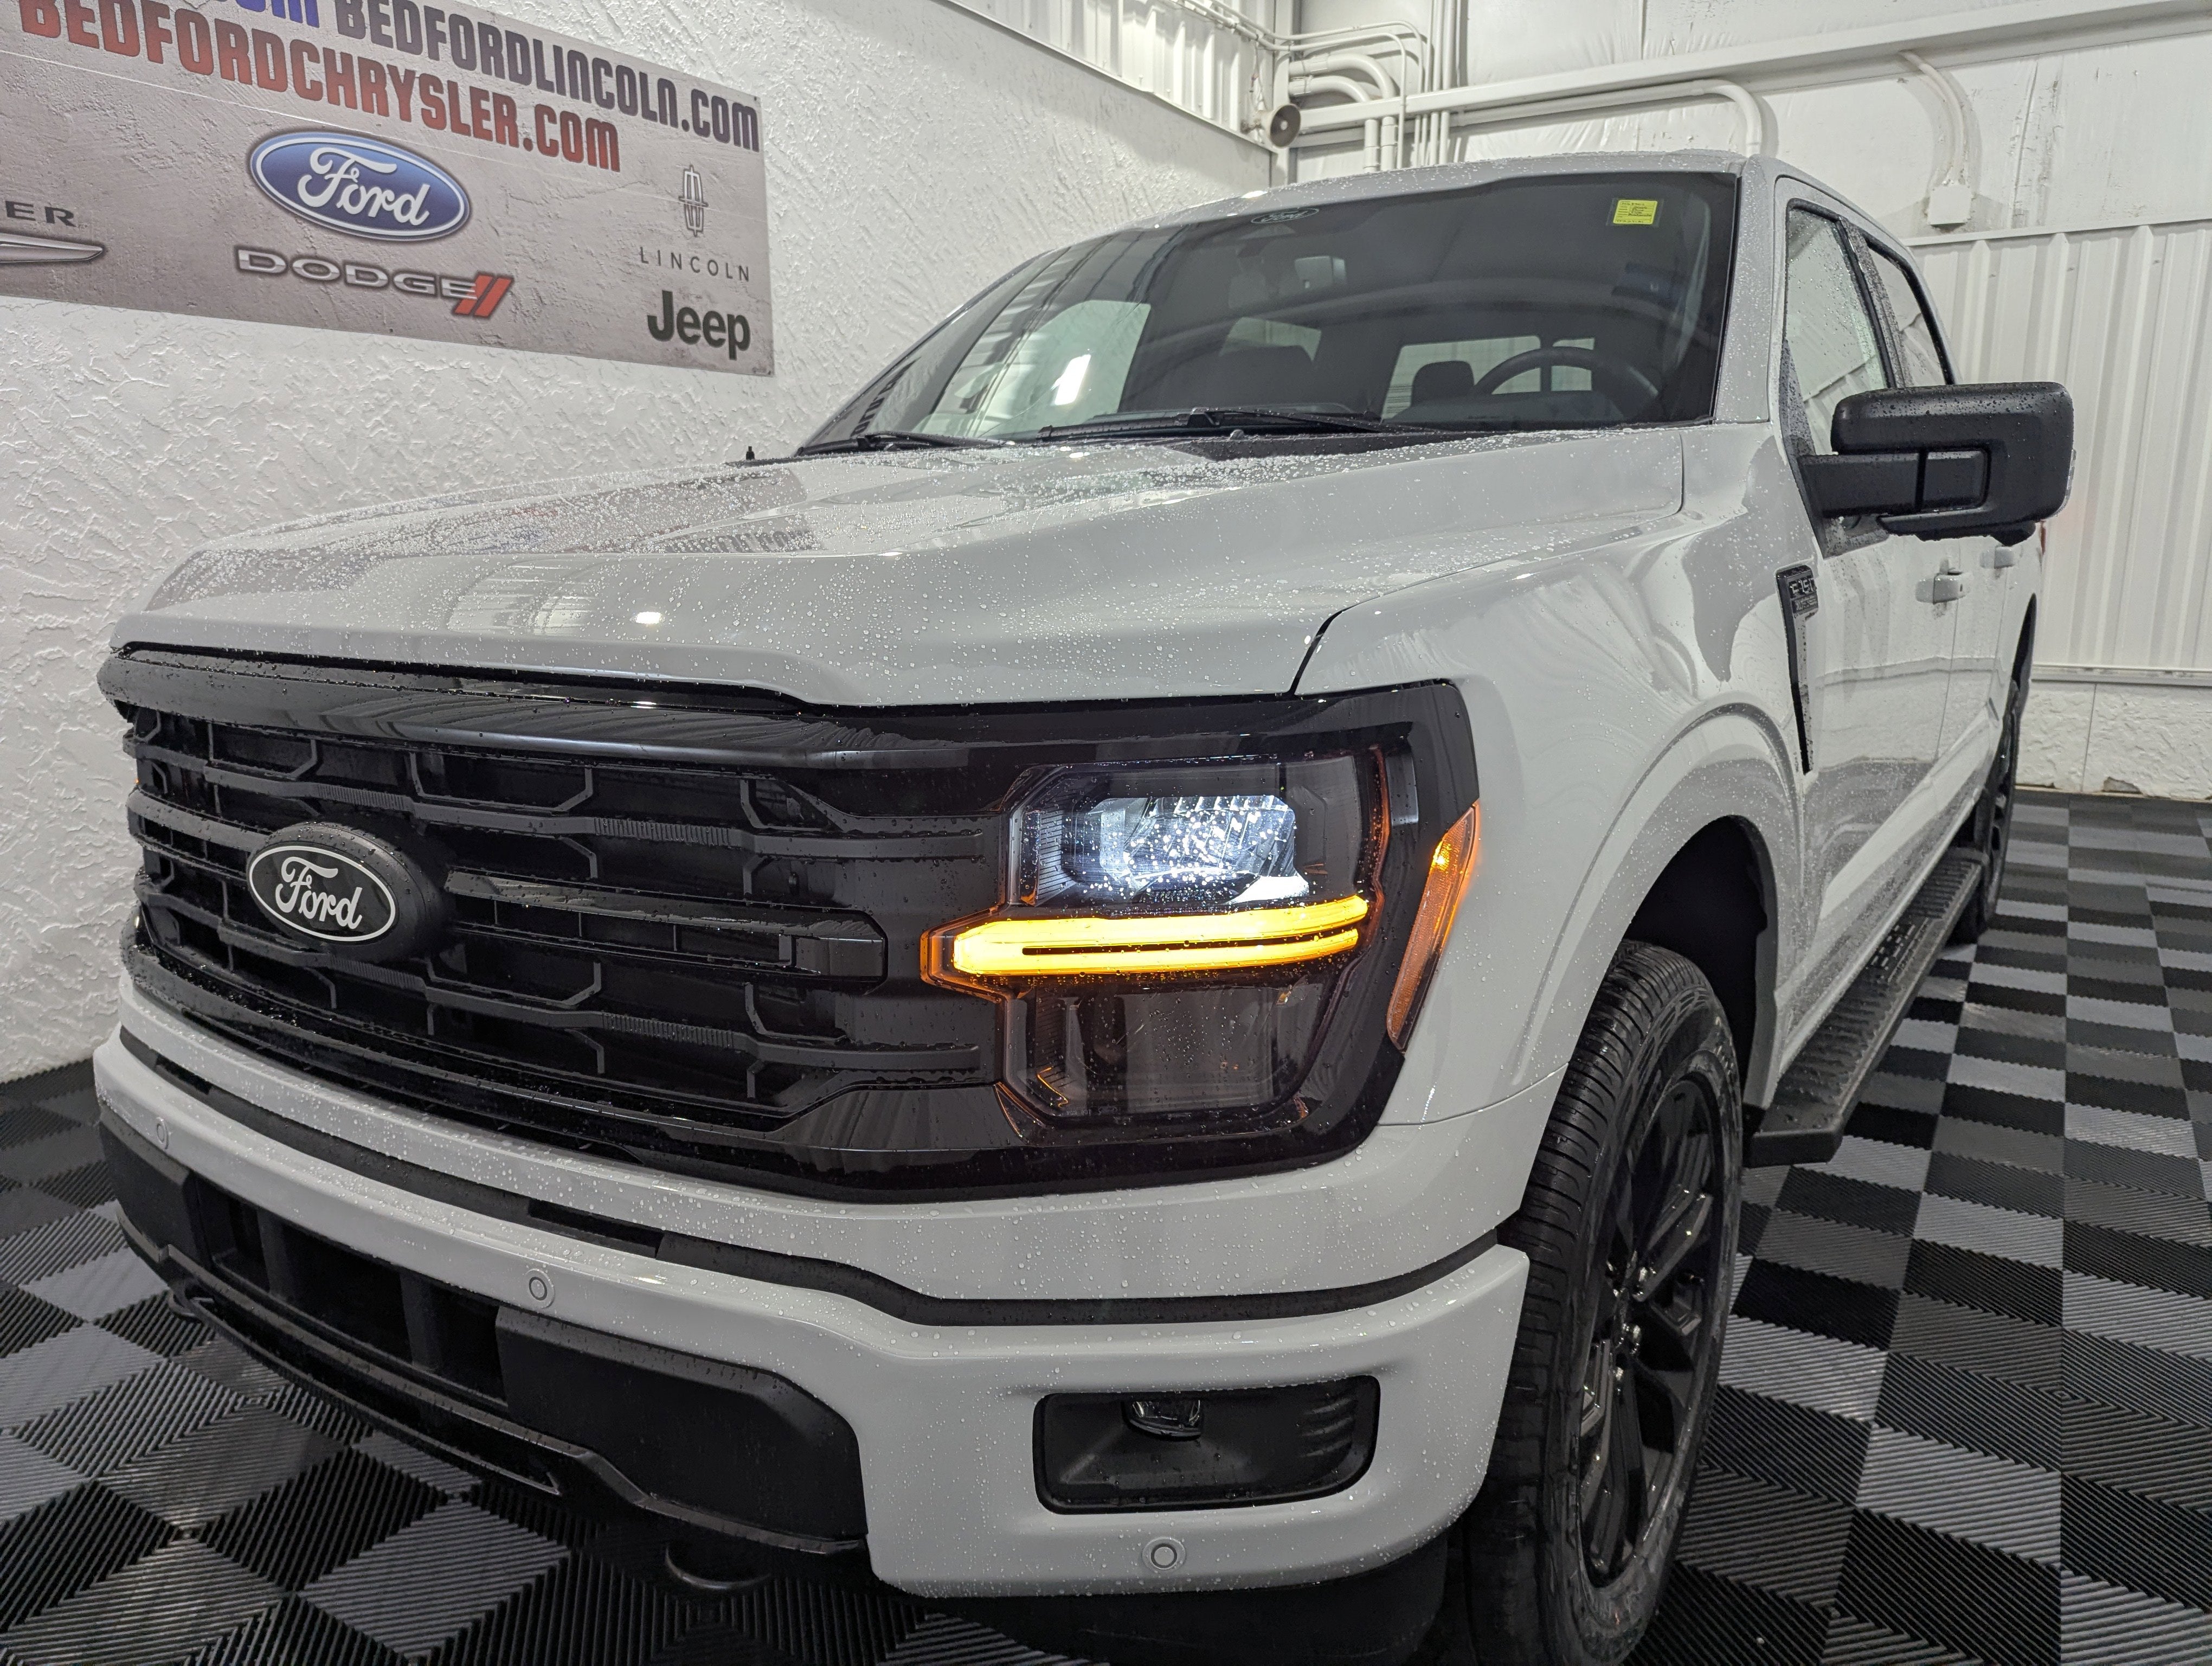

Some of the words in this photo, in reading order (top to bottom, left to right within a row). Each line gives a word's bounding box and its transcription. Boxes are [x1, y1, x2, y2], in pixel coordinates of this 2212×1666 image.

[298, 147, 430, 226] Ford
[238, 249, 478, 300] DODGE
[640, 246, 749, 282] LINCOLN
[647, 290, 751, 361] Jeep
[275, 857, 363, 930] Ford
